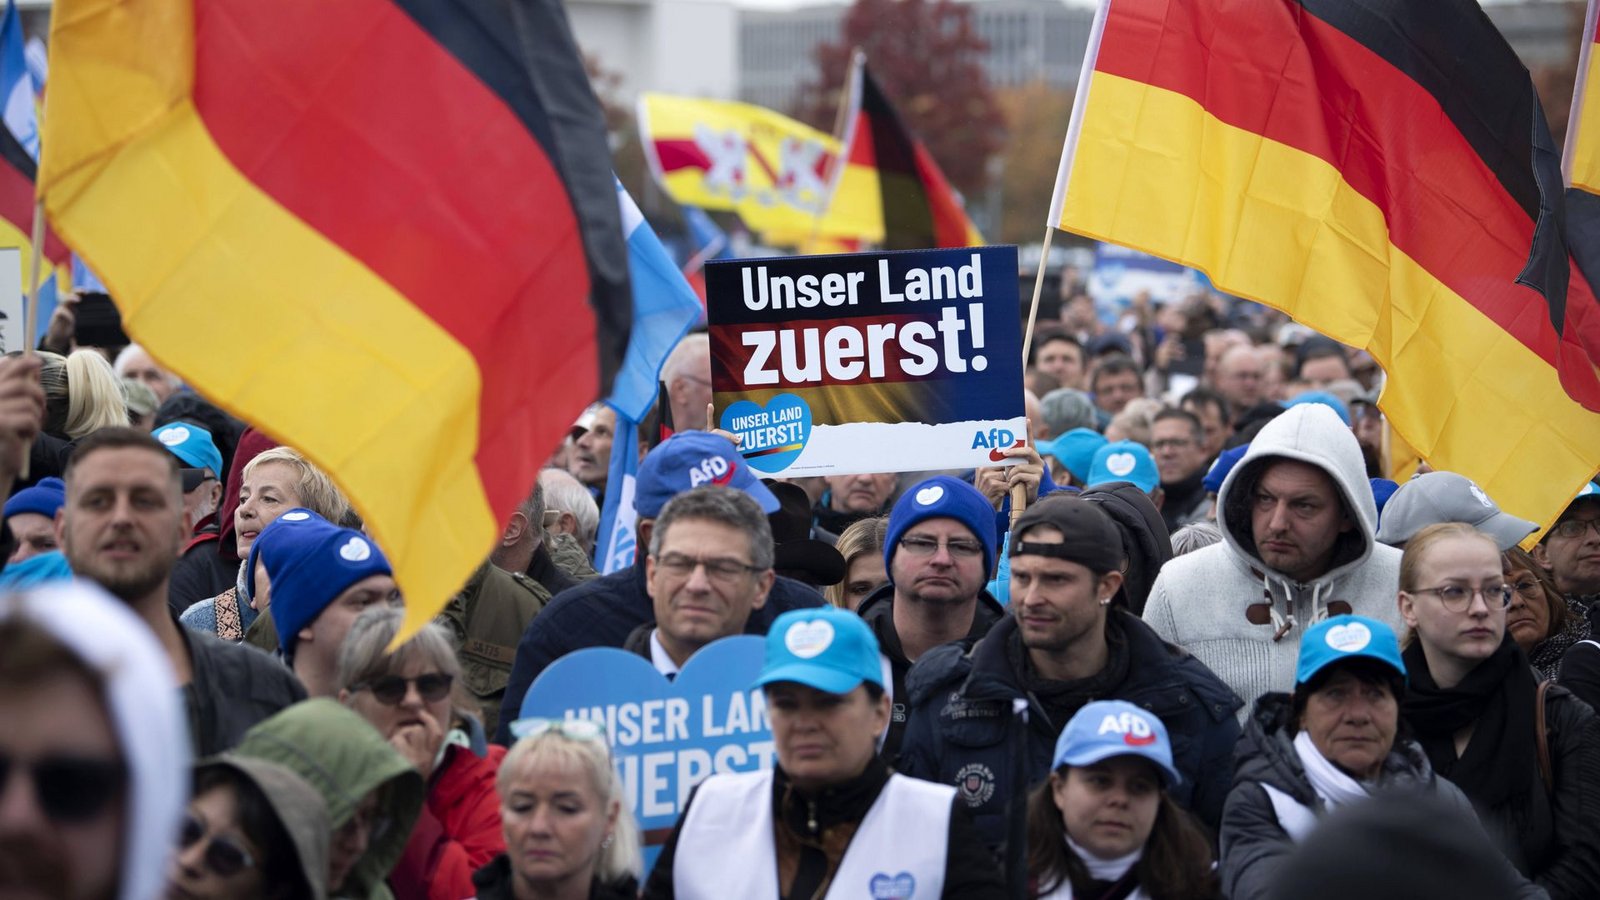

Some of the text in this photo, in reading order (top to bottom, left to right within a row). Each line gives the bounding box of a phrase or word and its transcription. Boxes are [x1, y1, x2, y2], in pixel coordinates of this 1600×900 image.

[742, 253, 983, 311] Unser Land
[742, 302, 988, 386] zuerst!
[732, 406, 803, 431] UNSER LAND
[735, 421, 804, 452] ZUERST!
[971, 427, 1015, 450] AfD
[689, 455, 729, 488] AfD
[702, 690, 771, 738] LAN
[1098, 711, 1151, 738] AfD
